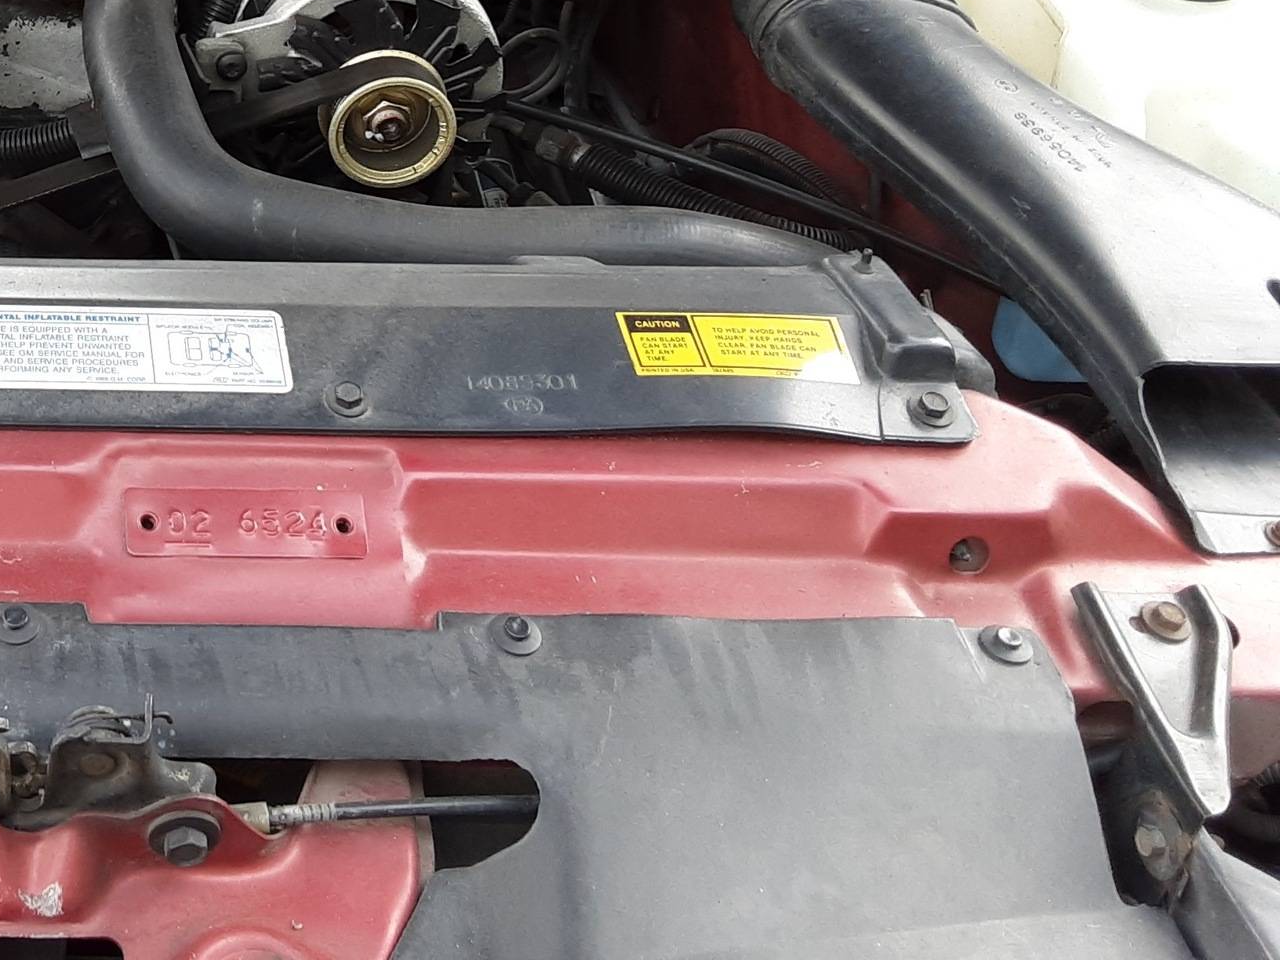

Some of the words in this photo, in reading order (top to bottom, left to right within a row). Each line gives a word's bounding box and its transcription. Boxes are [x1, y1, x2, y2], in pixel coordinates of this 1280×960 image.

[24, 313, 81, 321] INFLATABLE
[634, 320, 680, 328] CAUTION
[22, 325, 71, 333] EQUIPPED
[777, 329, 820, 337] PERSONAL
[19, 333, 73, 341] INFLATABLE
[38, 350, 79, 358] SERVICE
[169, 509, 212, 537] 02
